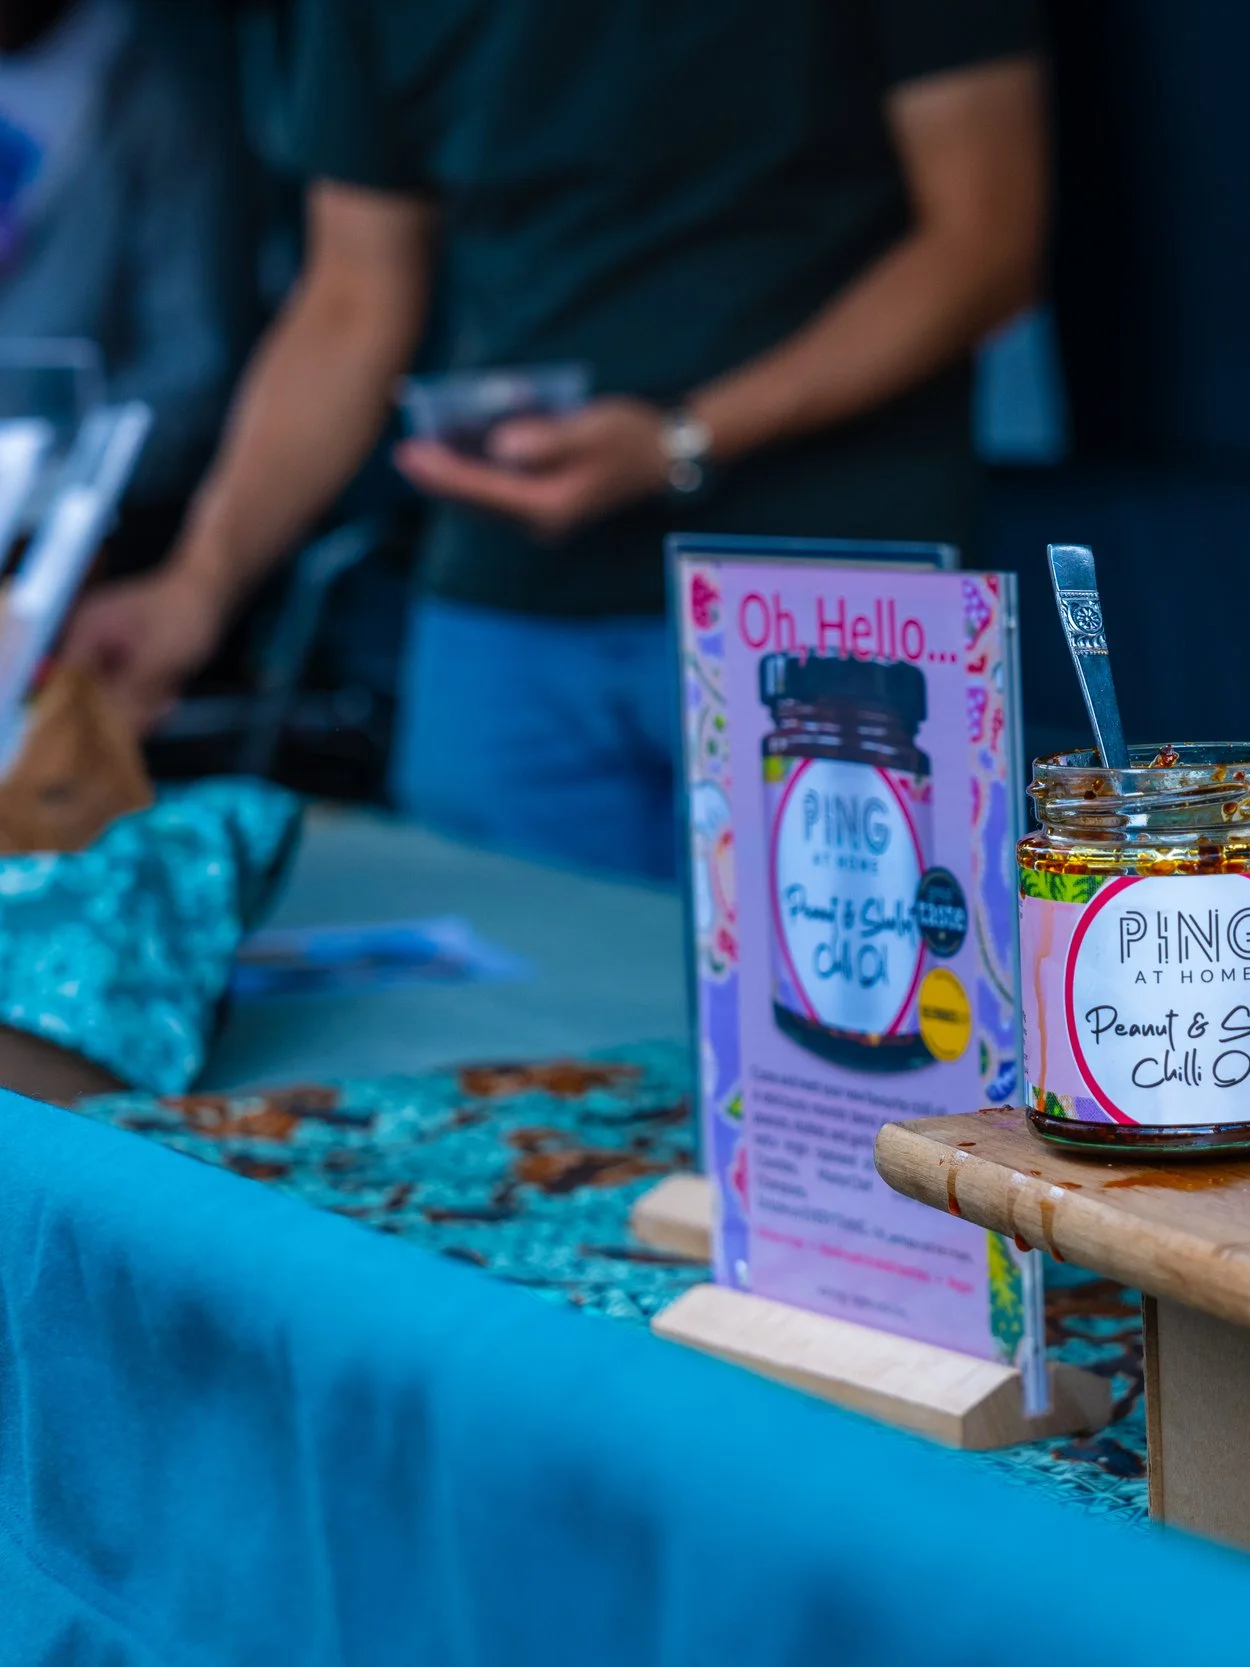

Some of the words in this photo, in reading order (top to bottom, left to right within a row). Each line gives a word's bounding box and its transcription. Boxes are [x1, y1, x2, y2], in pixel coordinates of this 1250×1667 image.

[738, 592, 808, 667] Oh,
[816, 596, 957, 662] Hello...
[803, 788, 893, 856] PING
[1134, 969, 1164, 984] AT
[1085, 1004, 1179, 1051] Peanut
[1187, 1012, 1210, 1039] &
[1131, 1048, 1203, 1089] Chilli
